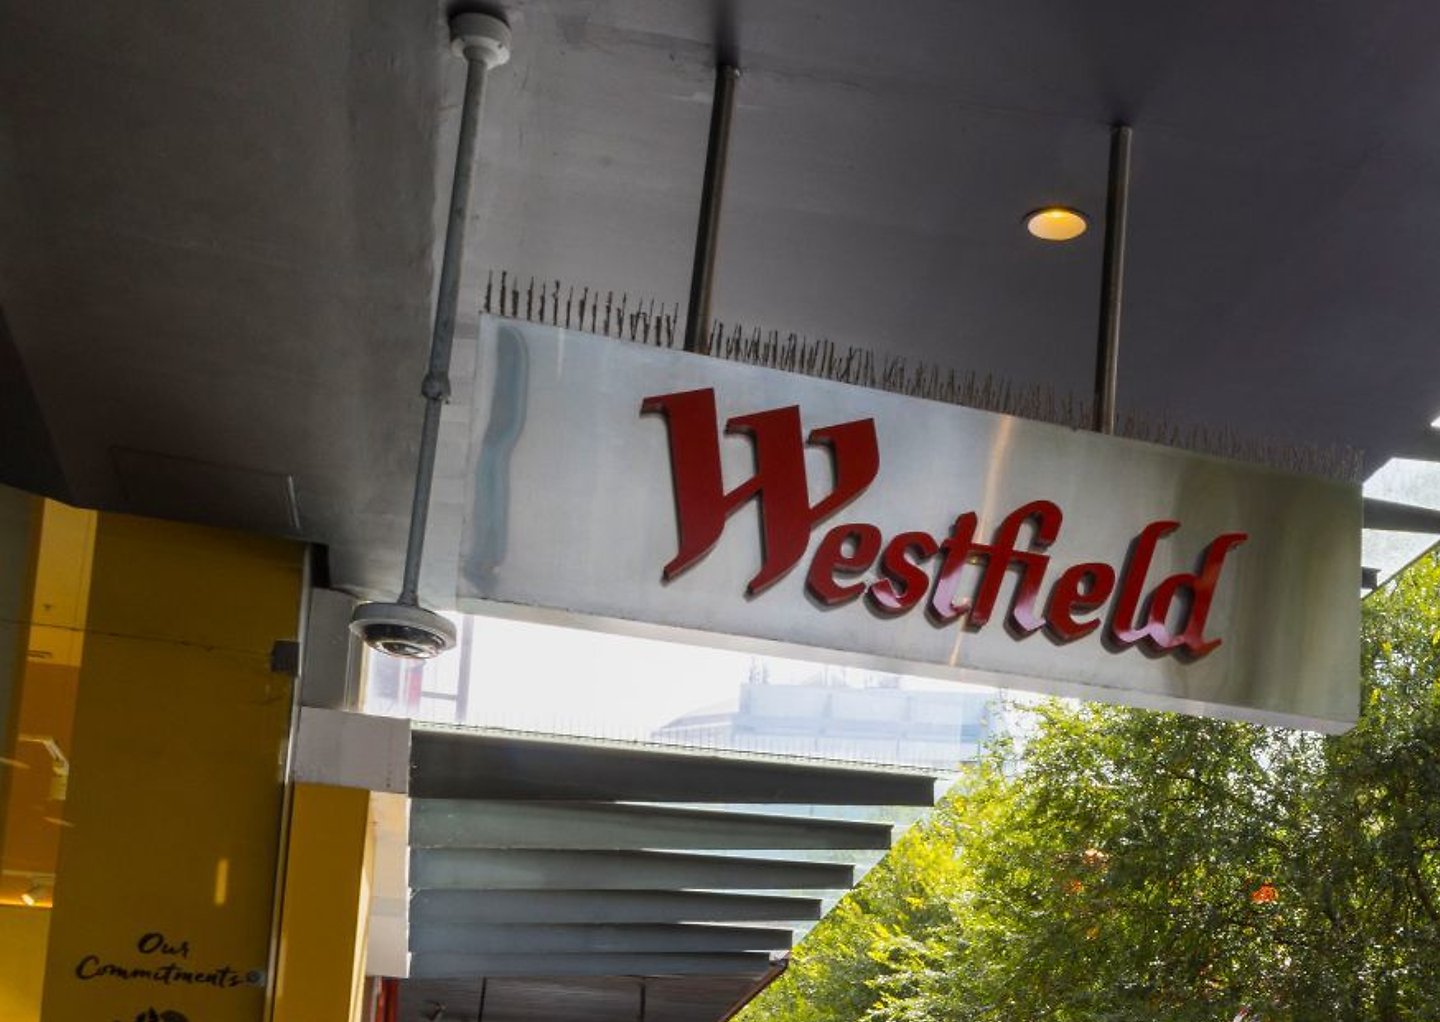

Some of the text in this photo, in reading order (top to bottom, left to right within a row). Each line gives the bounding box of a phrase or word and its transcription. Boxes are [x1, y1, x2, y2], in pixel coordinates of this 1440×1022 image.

[639, 386, 1248, 660] Westfield
[137, 932, 189, 958] Our
[76, 955, 242, 988] Commitments
